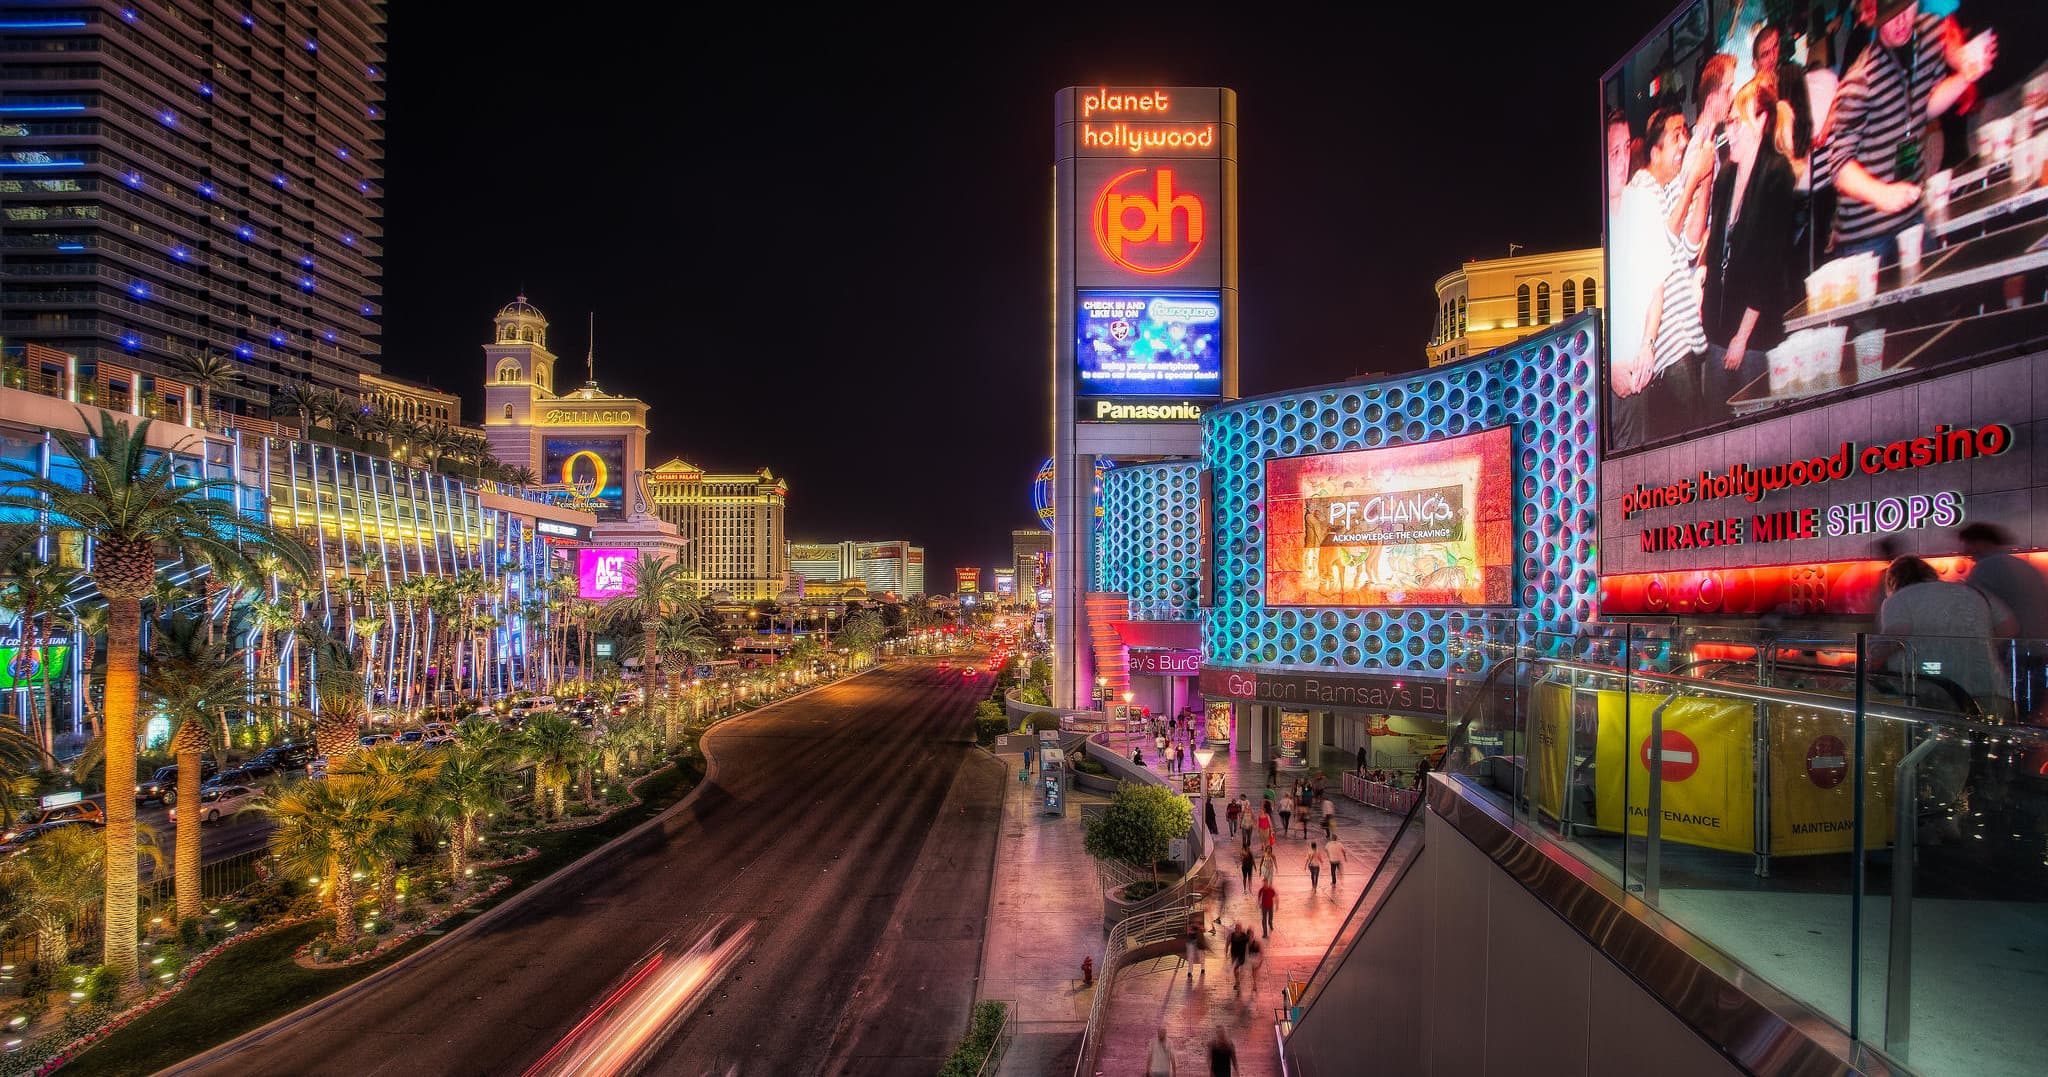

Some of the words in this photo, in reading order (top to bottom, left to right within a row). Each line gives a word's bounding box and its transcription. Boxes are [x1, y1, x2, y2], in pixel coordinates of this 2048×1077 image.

[1084, 88, 1168, 117] planet
[1084, 124, 1213, 152] hollywood
[1107, 170, 1203, 258] ph
[1083, 301, 1114, 310] CHECK
[1115, 301, 1125, 310] IN
[1126, 301, 1146, 310] AND
[1090, 310, 1110, 318] LIKE
[1111, 310, 1124, 318] US
[1125, 310, 1139, 318] ON
[1152, 302, 1217, 320] foursquare
[544, 409, 632, 425] BELLAGIO
[1097, 401, 1201, 419] Panasonic
[1622, 483, 1698, 519] planet
[1698, 441, 1856, 502] hollywood
[1860, 423, 2012, 474] casino
[1329, 501, 1360, 529] P.F.
[1640, 518, 1743, 553] MIRACLE
[1752, 509, 1820, 542] MILE
[1827, 491, 1964, 537] SHOPS
[1332, 531, 1394, 542] ACKNOWLEDGE
[1396, 531, 1411, 540] THE
[596, 556, 625, 577] ACT
[1228, 673, 1296, 699] Gordon
[1304, 679, 1412, 709] Ramsay's
[1792, 818, 1856, 834] MAINTENAN
